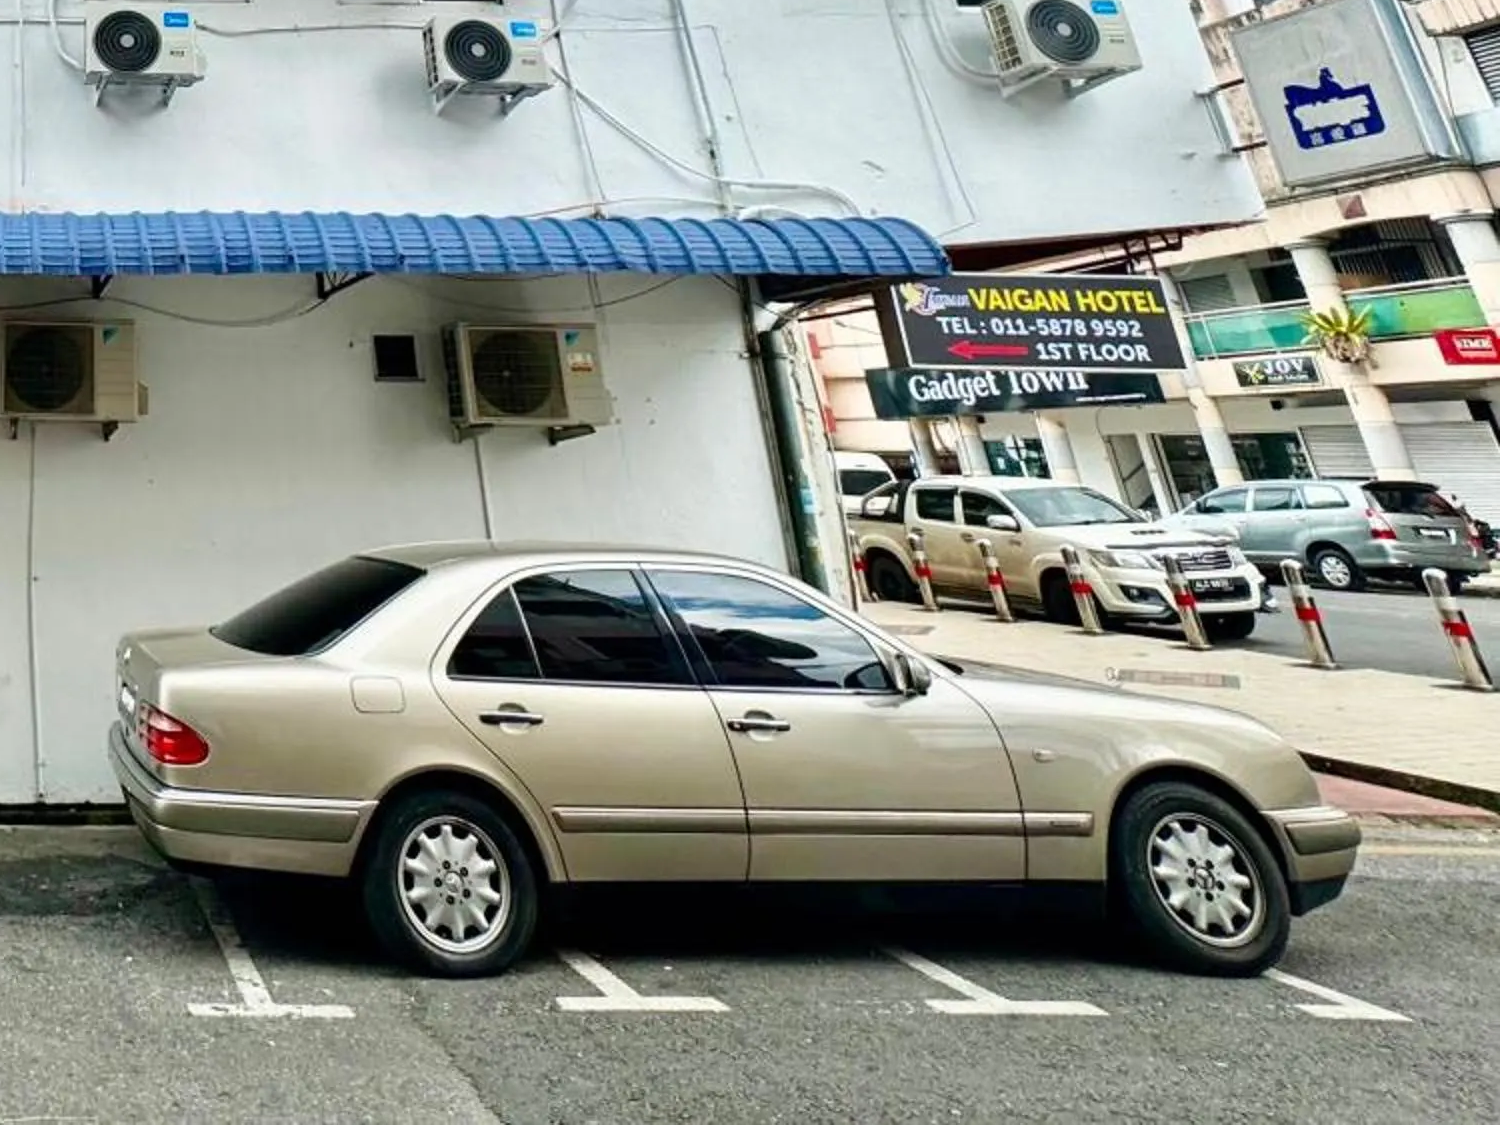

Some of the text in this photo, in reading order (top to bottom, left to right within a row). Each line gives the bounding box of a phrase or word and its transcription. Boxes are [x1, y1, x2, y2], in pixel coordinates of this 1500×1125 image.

[967, 288, 1071, 312] VAIGAN
[1077, 289, 1165, 313] HOTEL
[990, 317, 1087, 337] 011-5878
[1092, 319, 1144, 337] 9592
[1036, 343, 1152, 362] 1ST FLOOR
[908, 371, 1000, 406] Gadget
